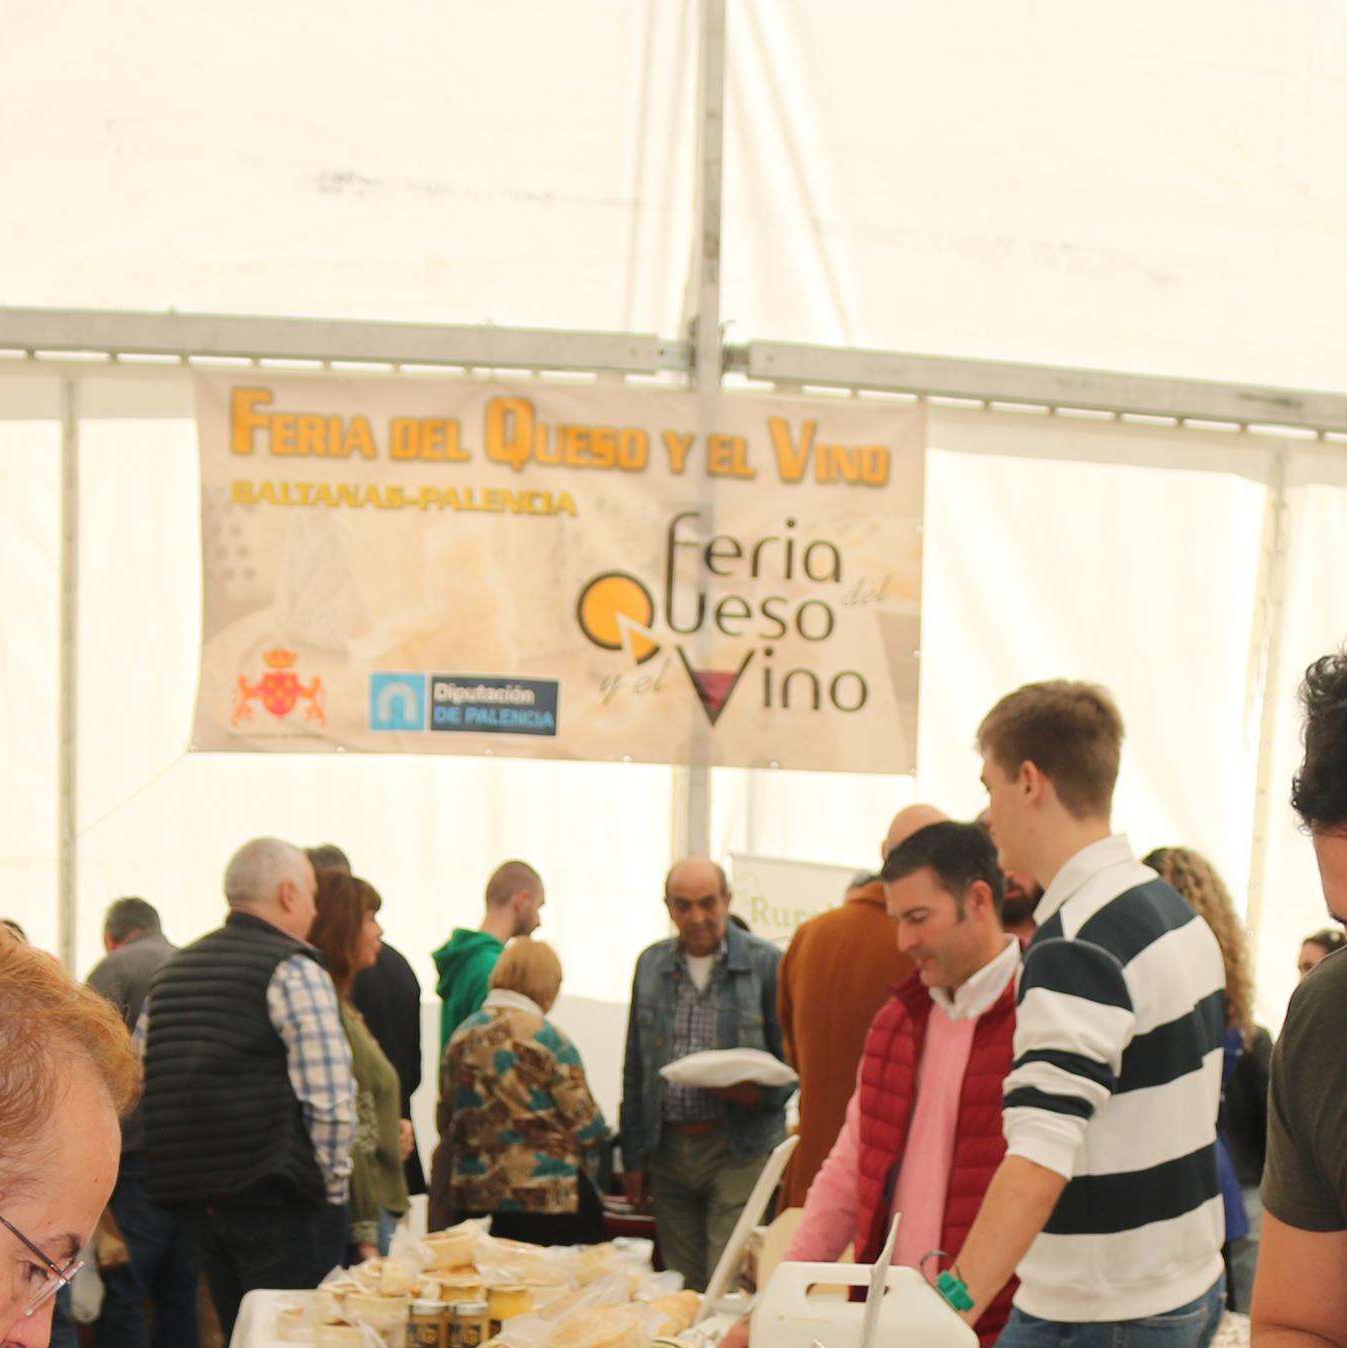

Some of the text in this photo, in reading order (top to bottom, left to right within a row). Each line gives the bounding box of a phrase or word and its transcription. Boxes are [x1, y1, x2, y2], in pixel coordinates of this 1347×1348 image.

[389, 415, 471, 462] DEL
[485, 395, 650, 472] QUESO
[662, 430, 696, 475] Y
[706, 432, 757, 478] EL
[766, 415, 892, 487] VINO
[433, 706, 554, 729] DE PALENCIA
